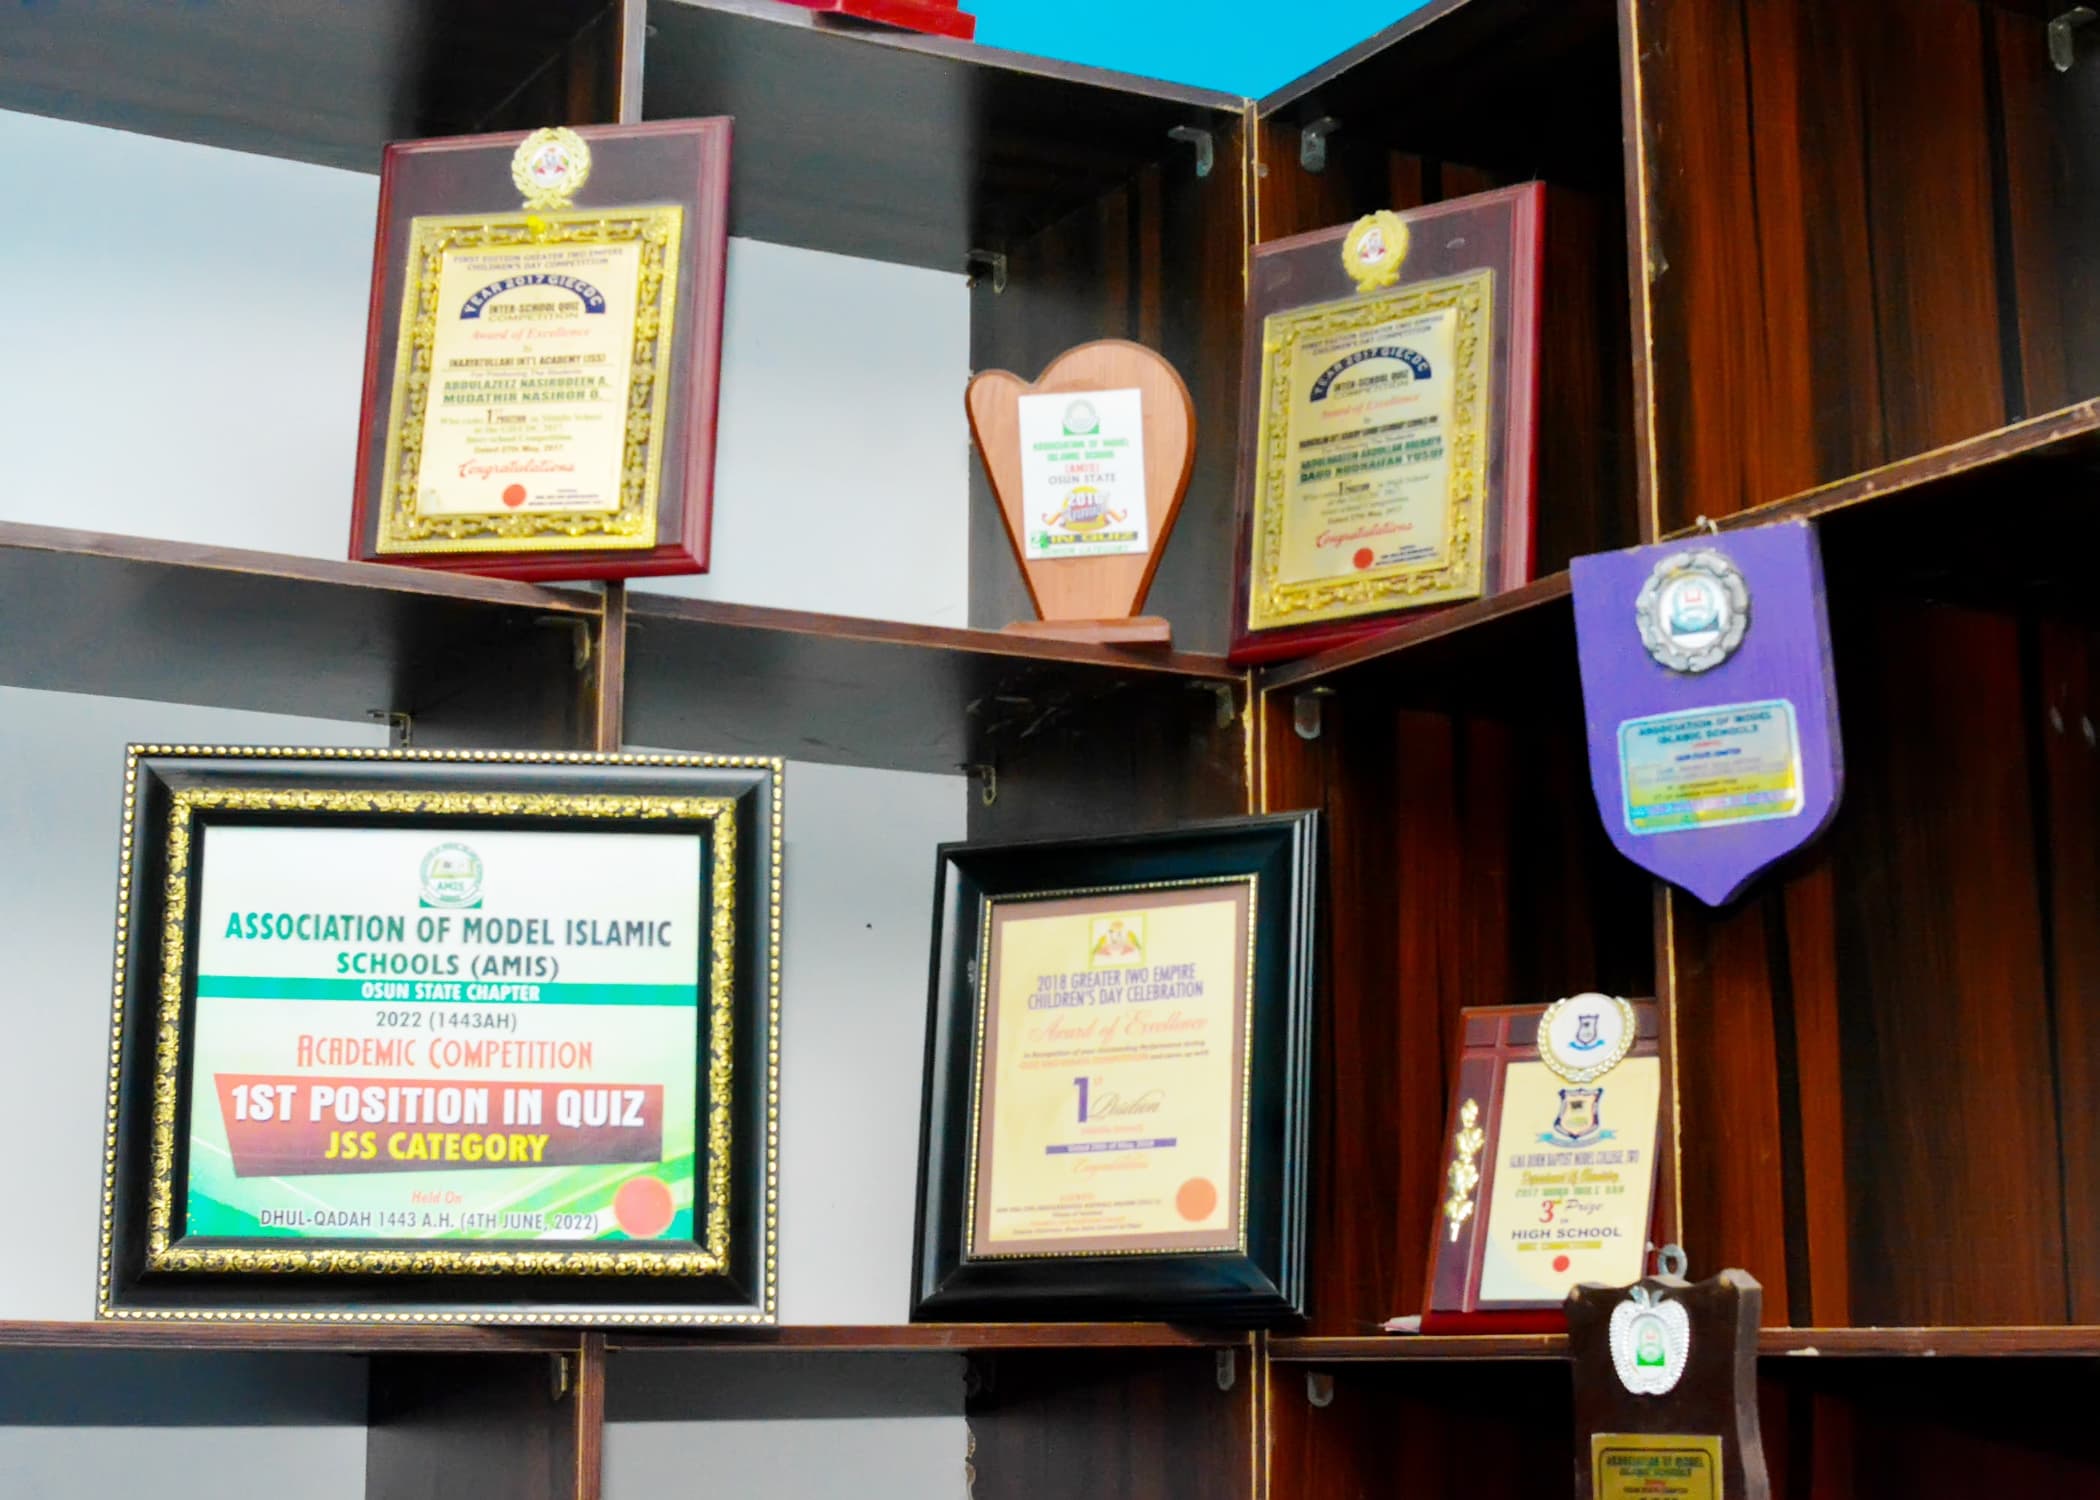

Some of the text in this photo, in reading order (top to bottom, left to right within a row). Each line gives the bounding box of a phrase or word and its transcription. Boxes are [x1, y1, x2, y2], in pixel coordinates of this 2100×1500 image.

[464, 281, 502, 313] YEAR
[505, 275, 546, 289] 2017
[458, 458, 576, 481] Congratulations
[1048, 473, 1117, 486] OSUN STATE
[1315, 521, 1415, 549] Congratulations
[224, 912, 673, 949] ASSOCIATION OF MODEL ISLAMIC
[336, 952, 560, 981] SCHOOLS (AMIS)
[1037, 963, 1197, 992] 2018 GREATER IWO EMPIRE
[361, 983, 540, 1002] OSUN STATE CHAPTER
[1028, 981, 1204, 1010] CHILDREN'S DAY CELEBRATION
[376, 1011, 518, 1033] 2022 (1443AH)
[1028, 1008, 1210, 1044] Award of Excellence
[230, 1084, 646, 1128] 1ST POSITION IN QUIZ
[324, 1131, 551, 1163] JSS CATEGORY
[412, 1190, 443, 1205] Held
[1565, 1198, 1605, 1216] Prize
[260, 1209, 600, 1234] DHUL-QADAH 1443 A.H. (4TH JUNE, 2022)
[1511, 1226, 1623, 1241] HIGH SCHOOL
